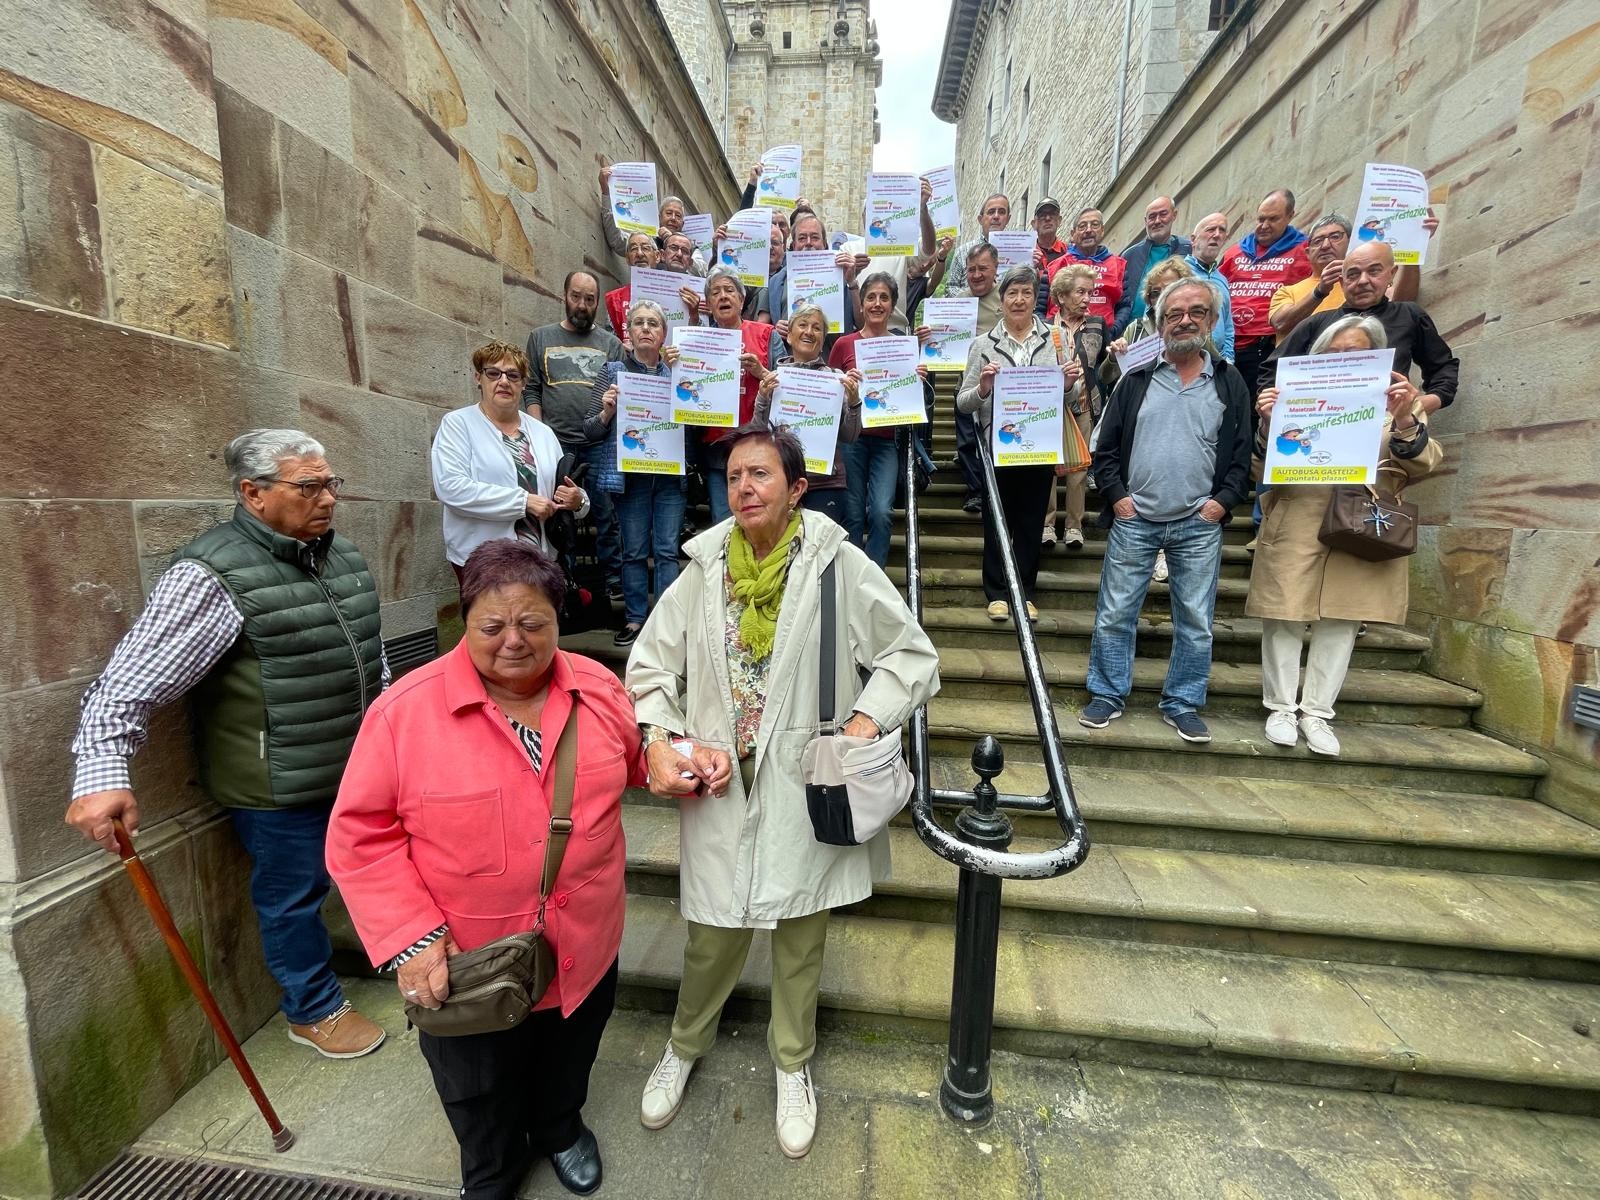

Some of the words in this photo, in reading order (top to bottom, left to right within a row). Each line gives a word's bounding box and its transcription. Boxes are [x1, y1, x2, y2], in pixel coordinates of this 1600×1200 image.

[1390, 198, 1397, 208] 7
[1230, 289, 1272, 297] SOLDATA
[699, 361, 706, 371] 7
[883, 369, 889, 379] 7
[799, 404, 806, 414] 7
[1021, 401, 1028, 412] 7
[1289, 405, 1317, 413] Maietzak
[1317, 399, 1328, 412] 7
[1327, 404, 1345, 412] Mayo
[645, 409, 652, 420] 7
[1302, 405, 1376, 431] manifestazioa
